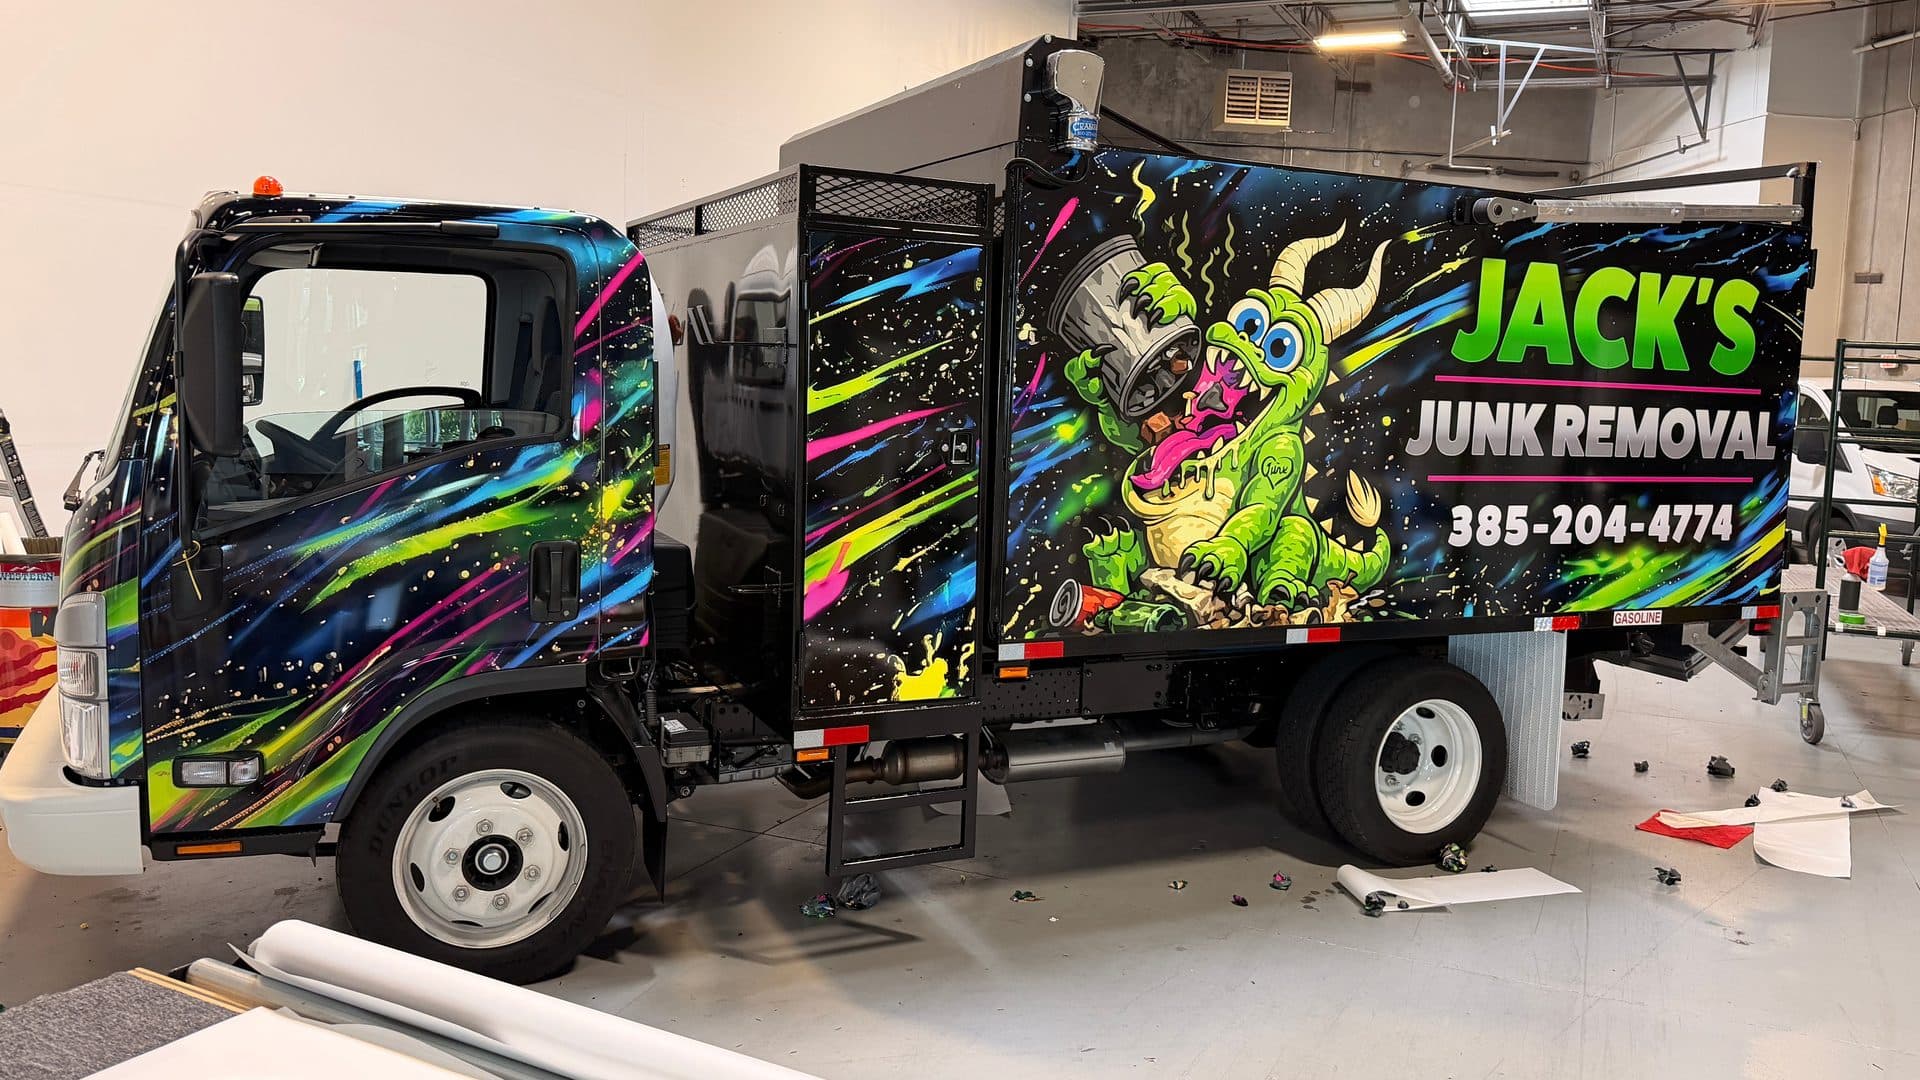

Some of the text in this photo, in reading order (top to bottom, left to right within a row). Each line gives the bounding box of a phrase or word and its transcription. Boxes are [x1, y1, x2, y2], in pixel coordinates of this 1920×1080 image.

[1451, 258, 1760, 376] JACK'S
[1405, 400, 1776, 460] JUNK REMOVAL
[1447, 504, 1733, 546] 385-204-4774
[1615, 612, 1661, 624] GASOLINE
[368, 757, 457, 856] DUNLOP
